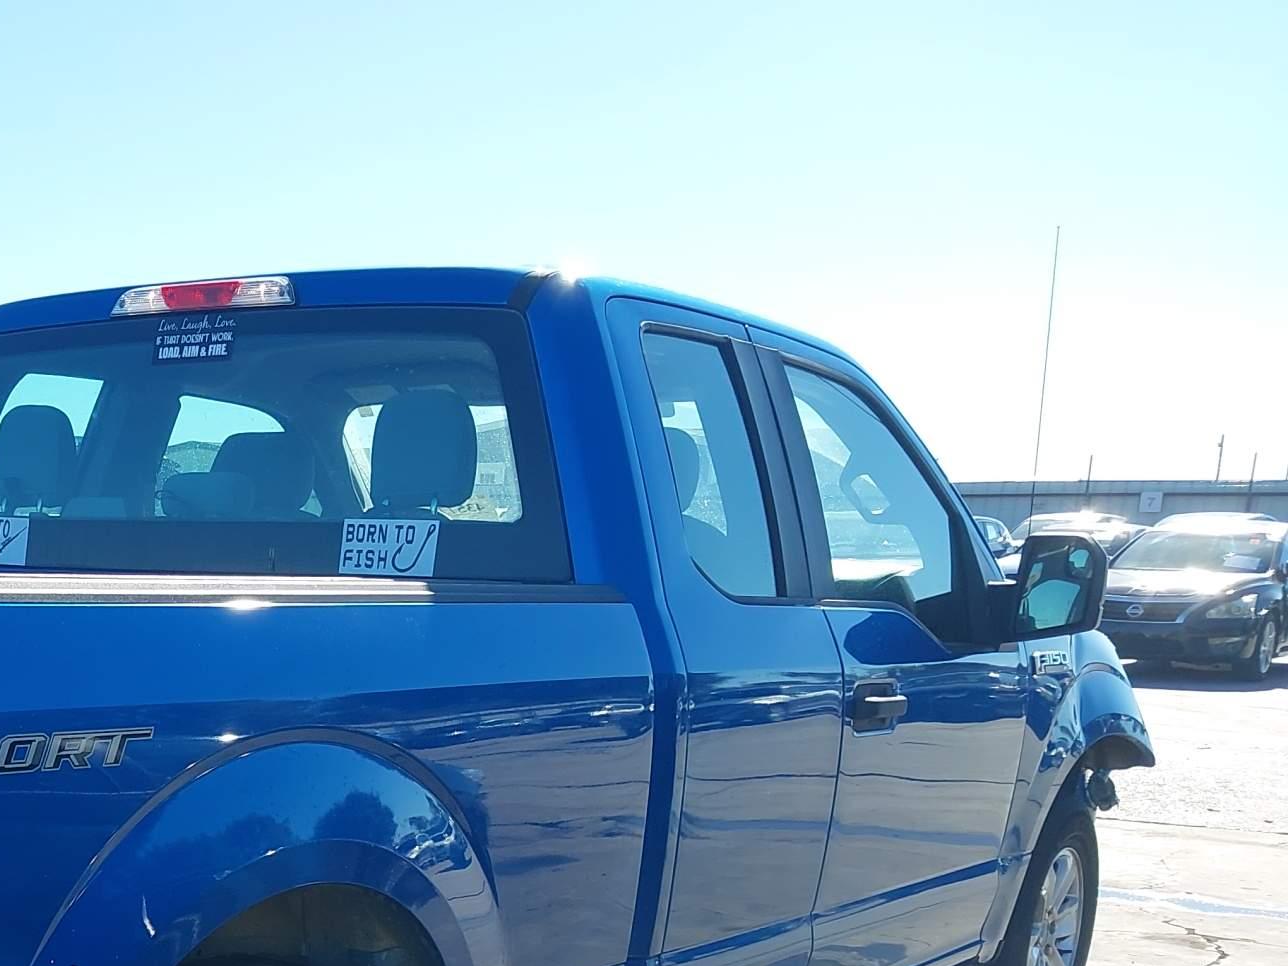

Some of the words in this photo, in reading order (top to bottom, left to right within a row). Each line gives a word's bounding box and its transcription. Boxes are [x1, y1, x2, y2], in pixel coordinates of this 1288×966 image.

[164, 335, 181, 345] THAT
[181, 333, 210, 344] DOESN'T
[212, 331, 234, 342] WORK.
[158, 346, 181, 360] LOAD,
[182, 345, 200, 358] AIM
[199, 346, 207, 357] &
[345, 523, 389, 544] BORN
[394, 524, 416, 545] TO
[342, 549, 388, 570] FISH
